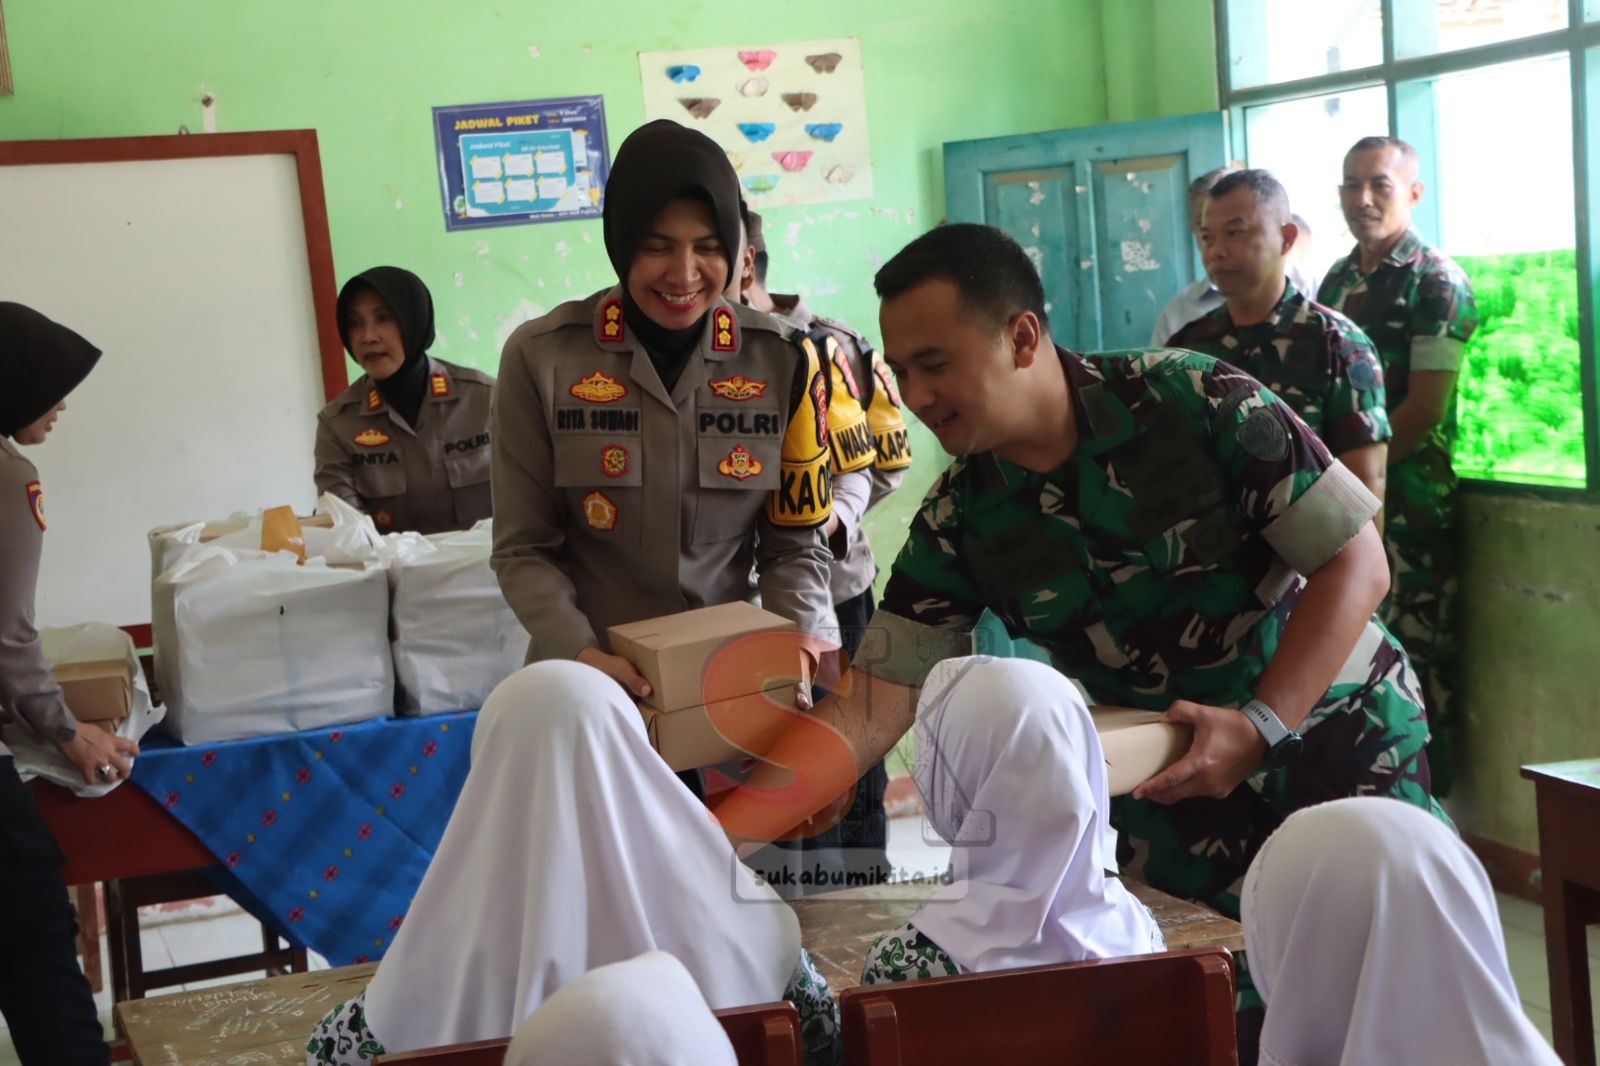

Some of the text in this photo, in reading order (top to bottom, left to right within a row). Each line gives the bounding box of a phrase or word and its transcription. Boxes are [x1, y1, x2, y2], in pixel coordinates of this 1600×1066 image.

[454, 118, 503, 131] JADWAL
[506, 114, 540, 127] PIKET
[700, 412, 779, 434] POLRI
[444, 432, 490, 455] POLRI
